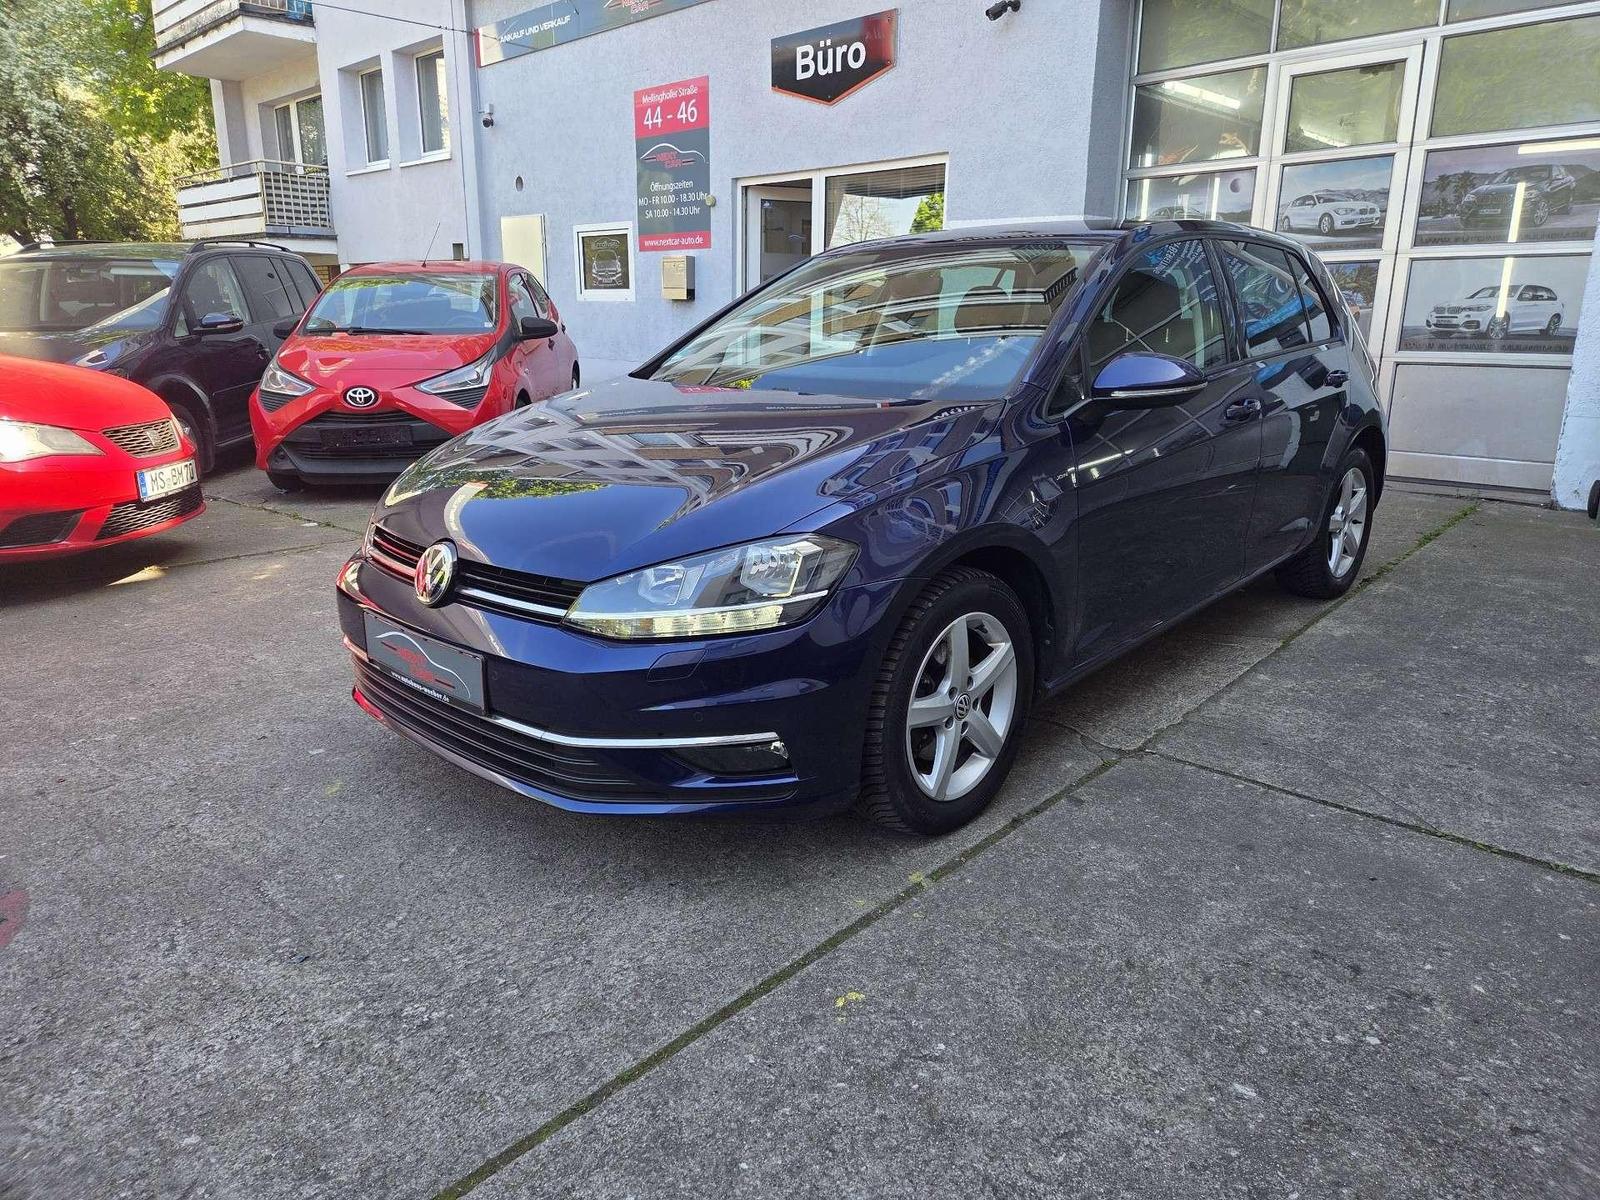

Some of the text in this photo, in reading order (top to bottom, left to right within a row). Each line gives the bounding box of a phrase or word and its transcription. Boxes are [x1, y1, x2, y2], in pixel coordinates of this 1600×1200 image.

[500, 14, 572, 43] ANKAUF UND VERKAUF
[796, 39, 866, 81] Büro
[679, 84, 698, 97] Straße
[643, 107, 663, 130] 44
[677, 99, 698, 124] 46
[650, 180, 694, 193] Öffnungszeiten
[638, 197, 649, 206] MO
[652, 195, 660, 205] FR
[661, 194, 676, 205] 10.00
[680, 193, 695, 203] 18.30
[696, 191, 707, 201] Uhr
[645, 209, 653, 219] SA
[654, 207, 669, 218] 10.00
[673, 206, 688, 216] 14.30
[689, 205, 701, 215] Uhr
[644, 235, 704, 247] www.nextcar-auto.de
[150, 472, 166, 492] MS
